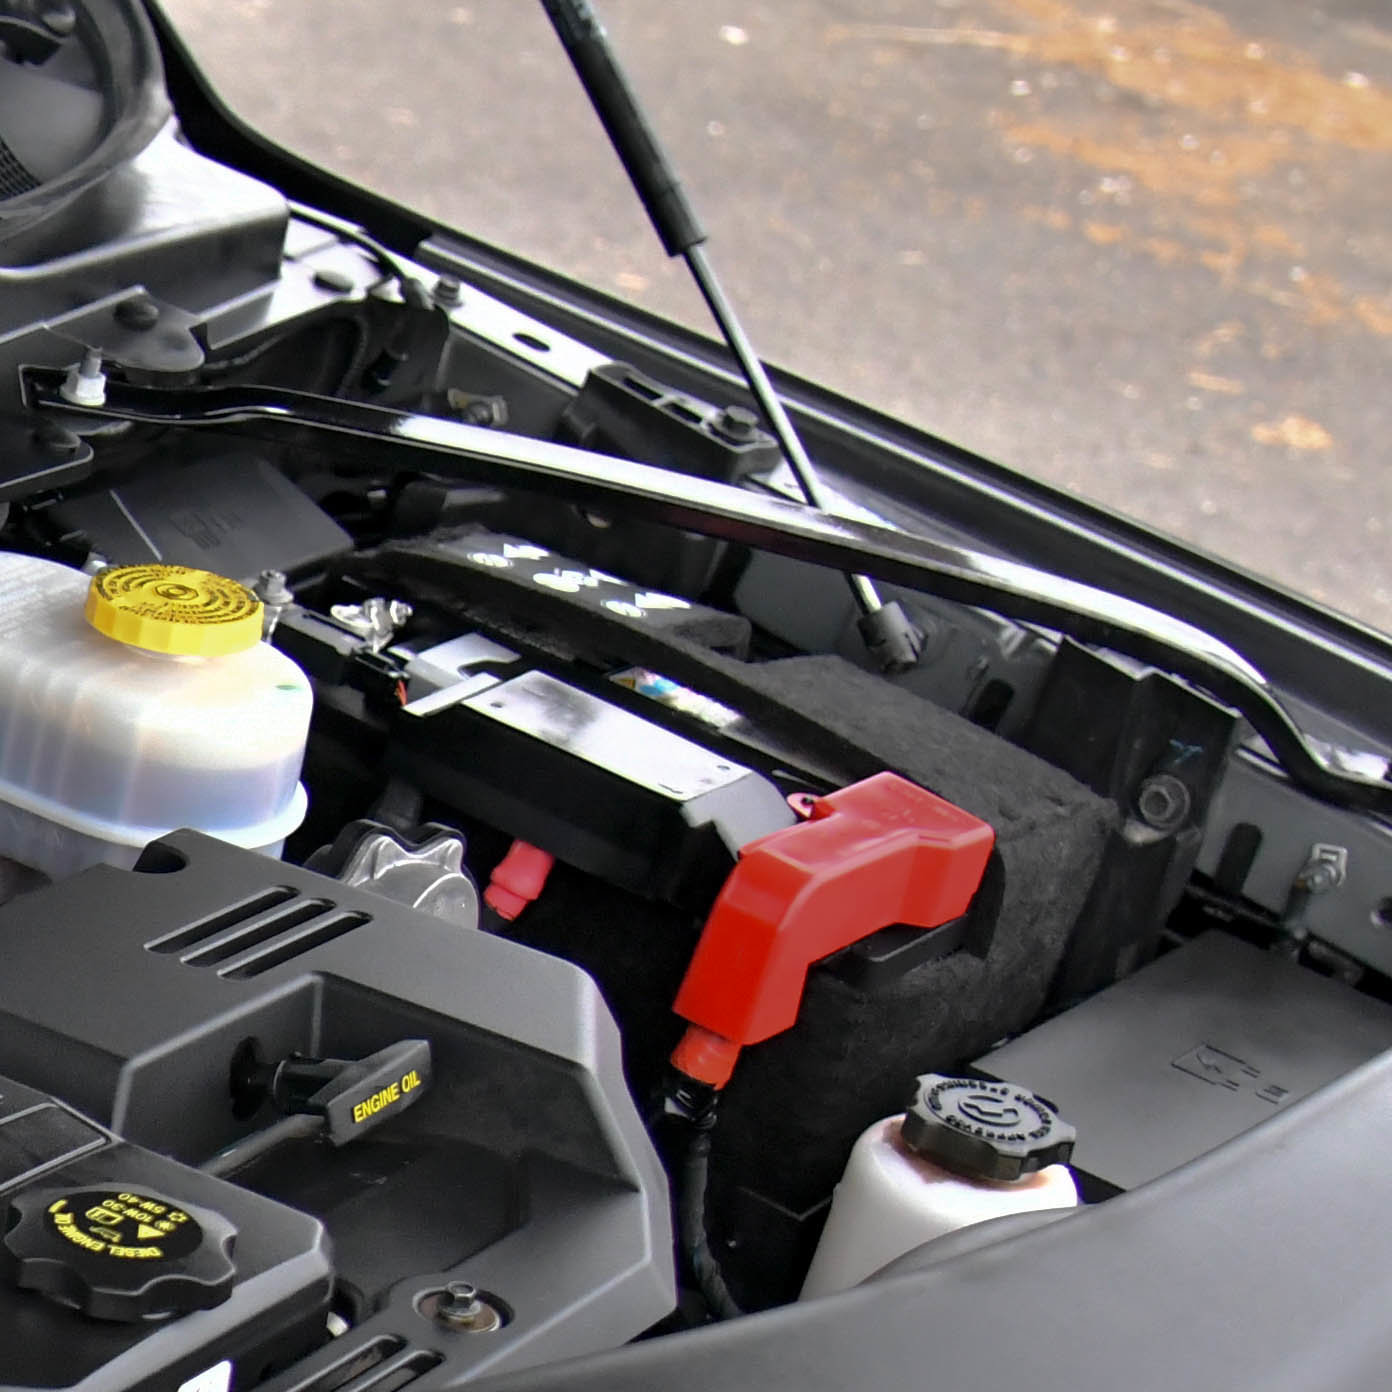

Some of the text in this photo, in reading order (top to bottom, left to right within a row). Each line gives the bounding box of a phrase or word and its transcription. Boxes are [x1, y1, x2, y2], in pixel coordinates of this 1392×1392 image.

[353, 1069, 421, 1123] ENGINE OIL
[108, 1245, 164, 1258] DIESEL
